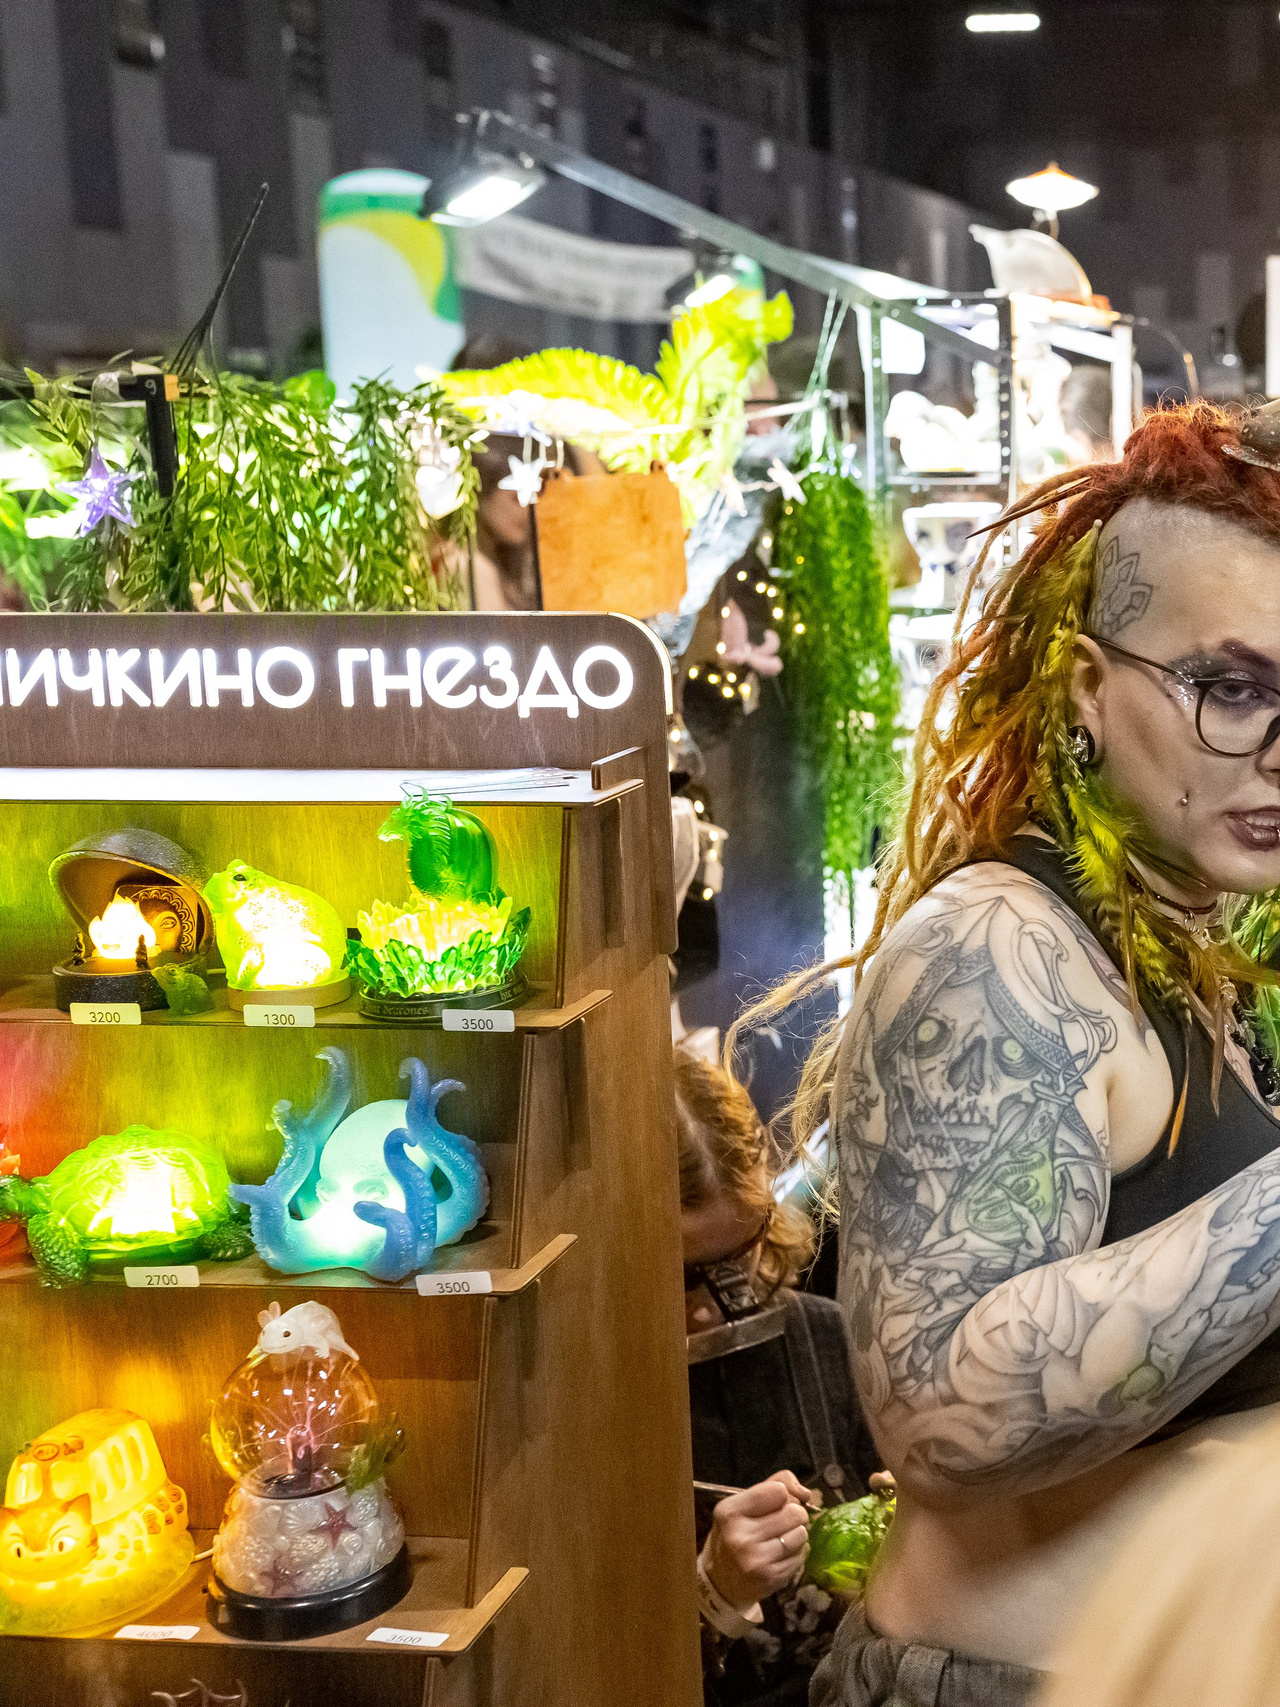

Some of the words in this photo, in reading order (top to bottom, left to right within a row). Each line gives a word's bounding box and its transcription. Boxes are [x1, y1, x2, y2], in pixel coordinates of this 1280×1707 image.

[0, 646, 315, 709] ИЧКИНО
[89, 1011, 121, 1024] 3200
[263, 1013, 296, 1026] 1300
[461, 1018, 494, 1030] 3500
[145, 1274, 179, 1286] 2700
[436, 1281, 471, 1294] 3500
